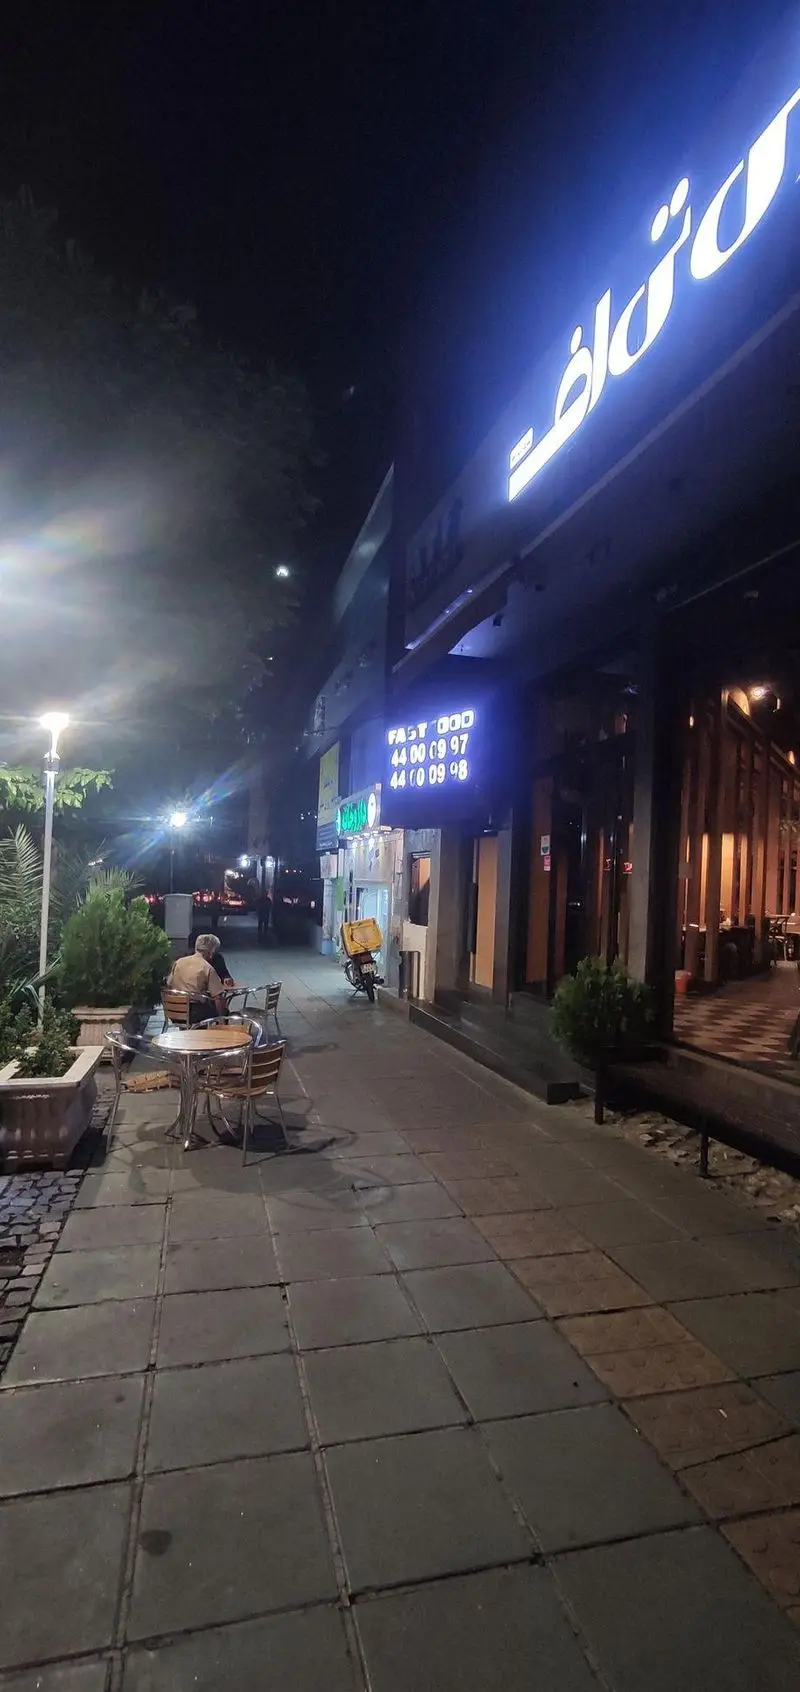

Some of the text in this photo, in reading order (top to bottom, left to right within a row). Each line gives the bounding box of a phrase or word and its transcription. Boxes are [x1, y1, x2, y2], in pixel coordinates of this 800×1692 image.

[388, 710, 475, 745] FAST OOD
[391, 733, 469, 767] 44 00 09 97
[390, 769, 406, 790] 44
[429, 763, 446, 785] 09
[449, 759, 468, 781] 98
